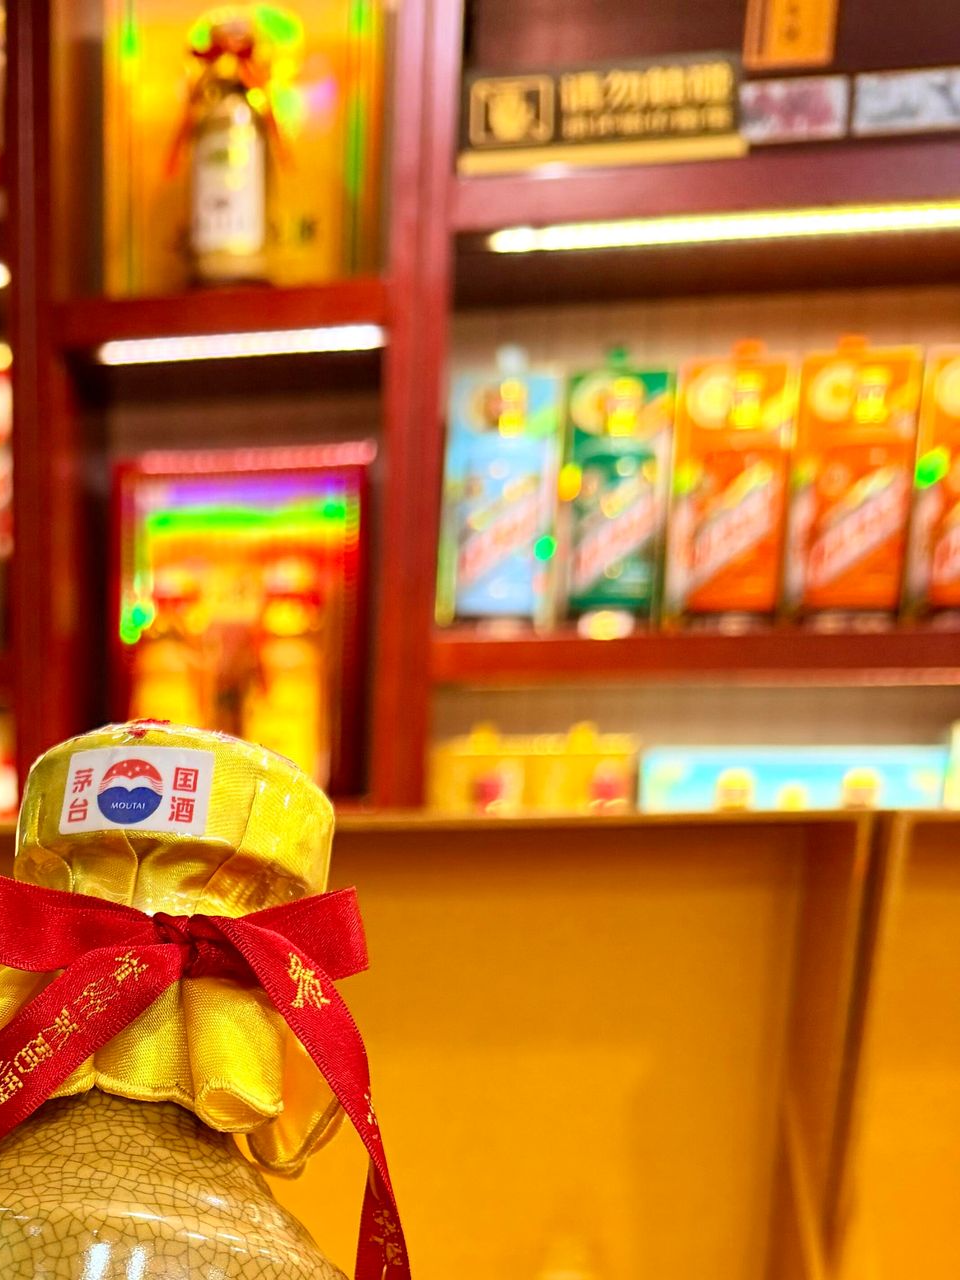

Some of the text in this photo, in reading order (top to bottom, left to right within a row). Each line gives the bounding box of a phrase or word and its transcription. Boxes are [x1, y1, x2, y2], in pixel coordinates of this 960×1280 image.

[67, 767, 95, 823] 茅台
[110, 801, 146, 811] MOUTAI
[168, 766, 199, 823] 国酒
